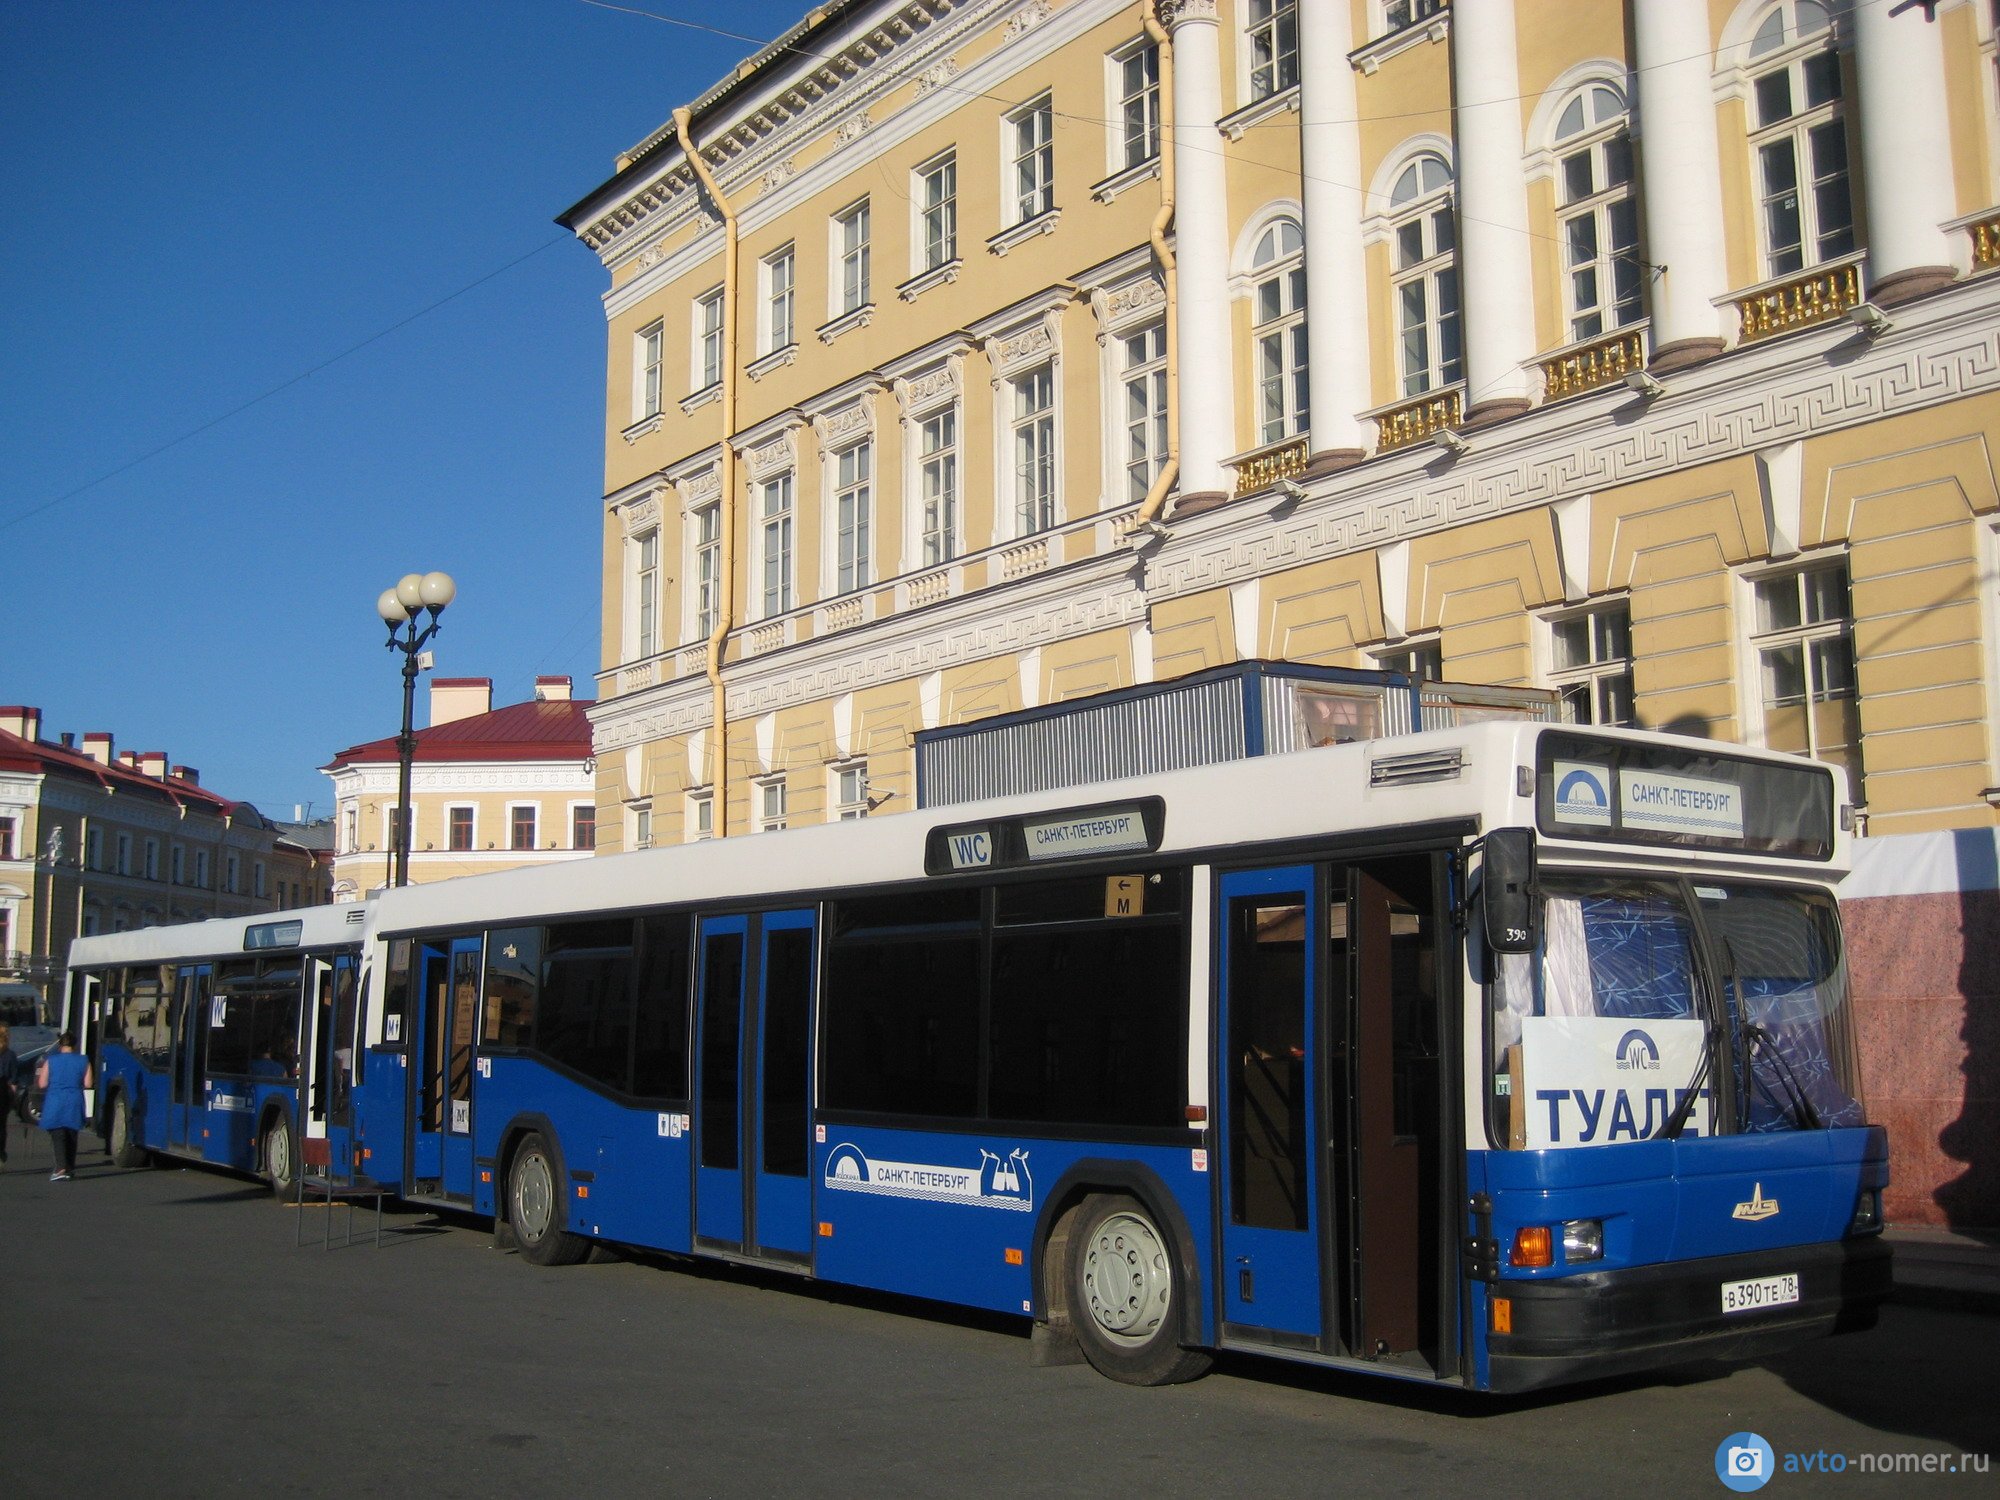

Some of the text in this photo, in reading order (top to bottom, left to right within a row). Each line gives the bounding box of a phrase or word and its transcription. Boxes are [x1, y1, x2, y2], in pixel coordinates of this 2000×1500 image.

[1632, 783, 1731, 812] САНКТ-ПЕТЕРБУРГ
[1036, 817, 1131, 844] САНКТ-ПЕТЕРБУРГ
[954, 834, 988, 865] WC
[1506, 928, 1526, 941] 390
[1629, 1046, 1648, 1070] WC
[1536, 1088, 1712, 1143] ТУАЛЕ
[877, 1167, 970, 1190] САНКТ-ПЕТЕРБУРГ
